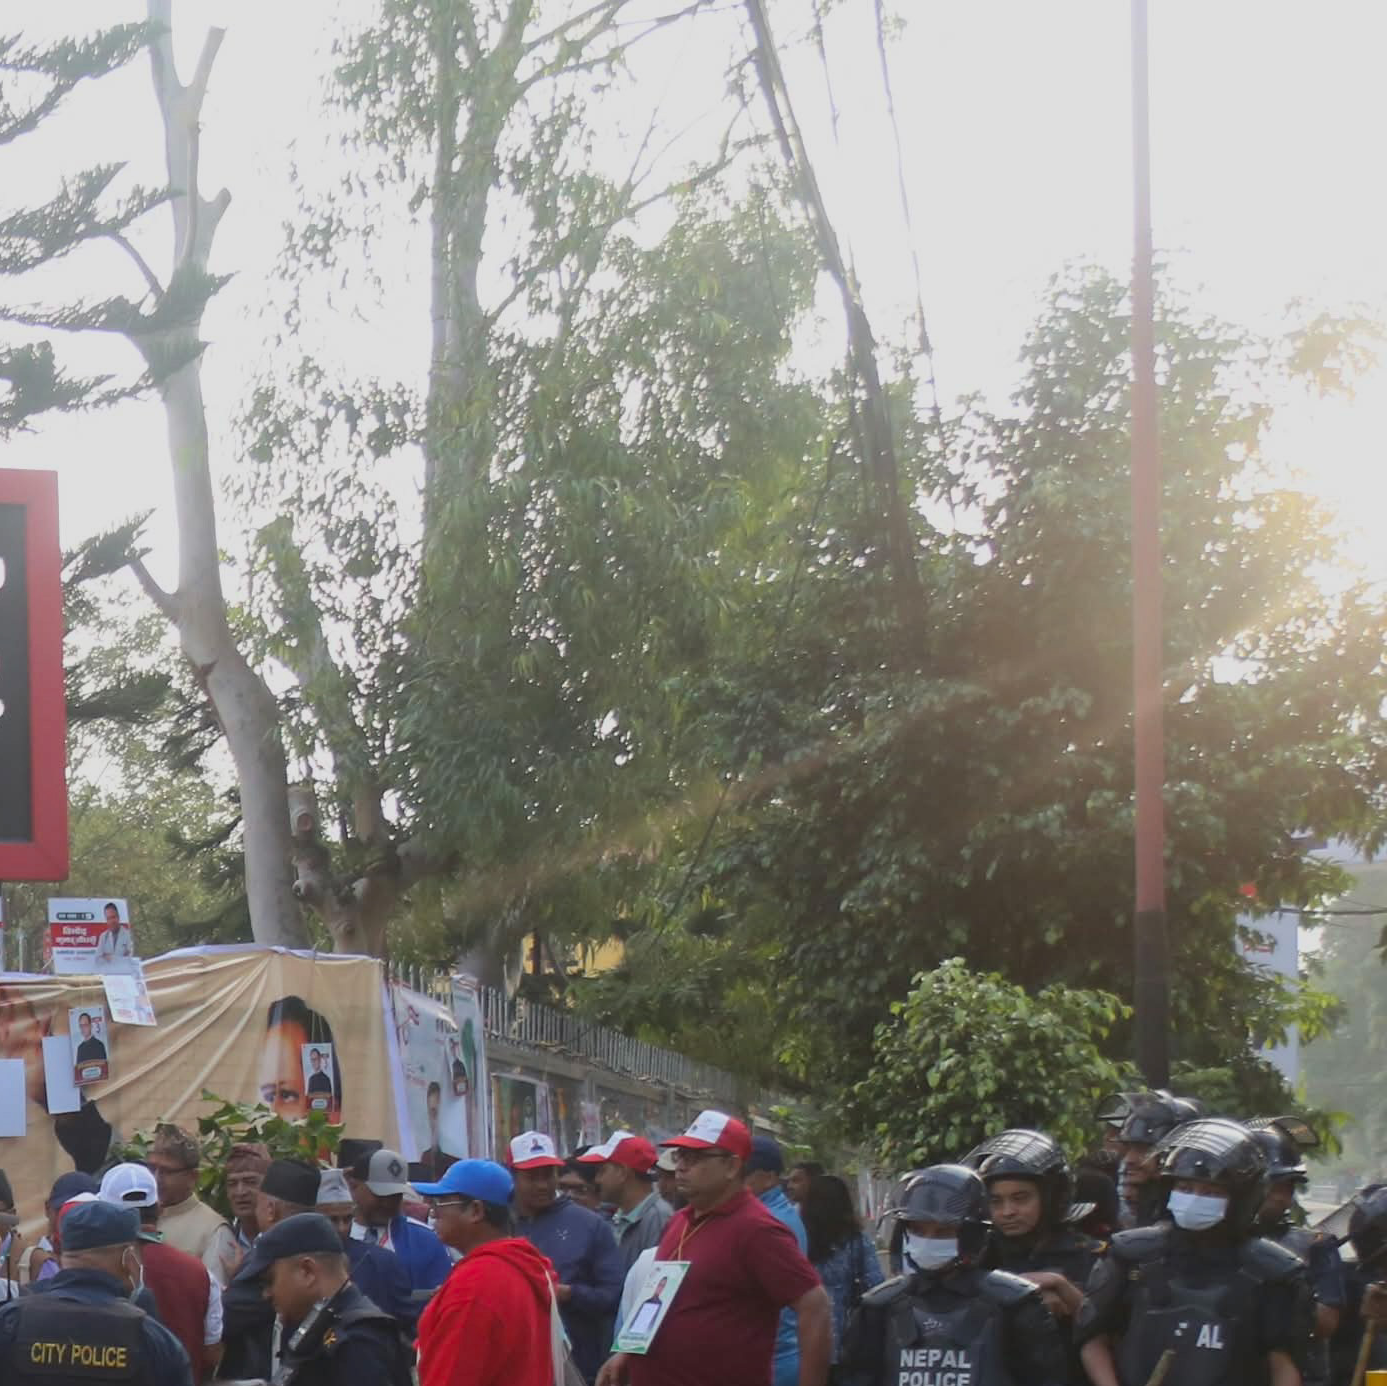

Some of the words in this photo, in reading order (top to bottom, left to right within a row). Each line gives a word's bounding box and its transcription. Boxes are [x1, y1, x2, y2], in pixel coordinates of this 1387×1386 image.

[31, 1342, 66, 1364] CITY
[71, 1344, 127, 1367] POLICE
[900, 1348, 972, 1369] NEPAL
